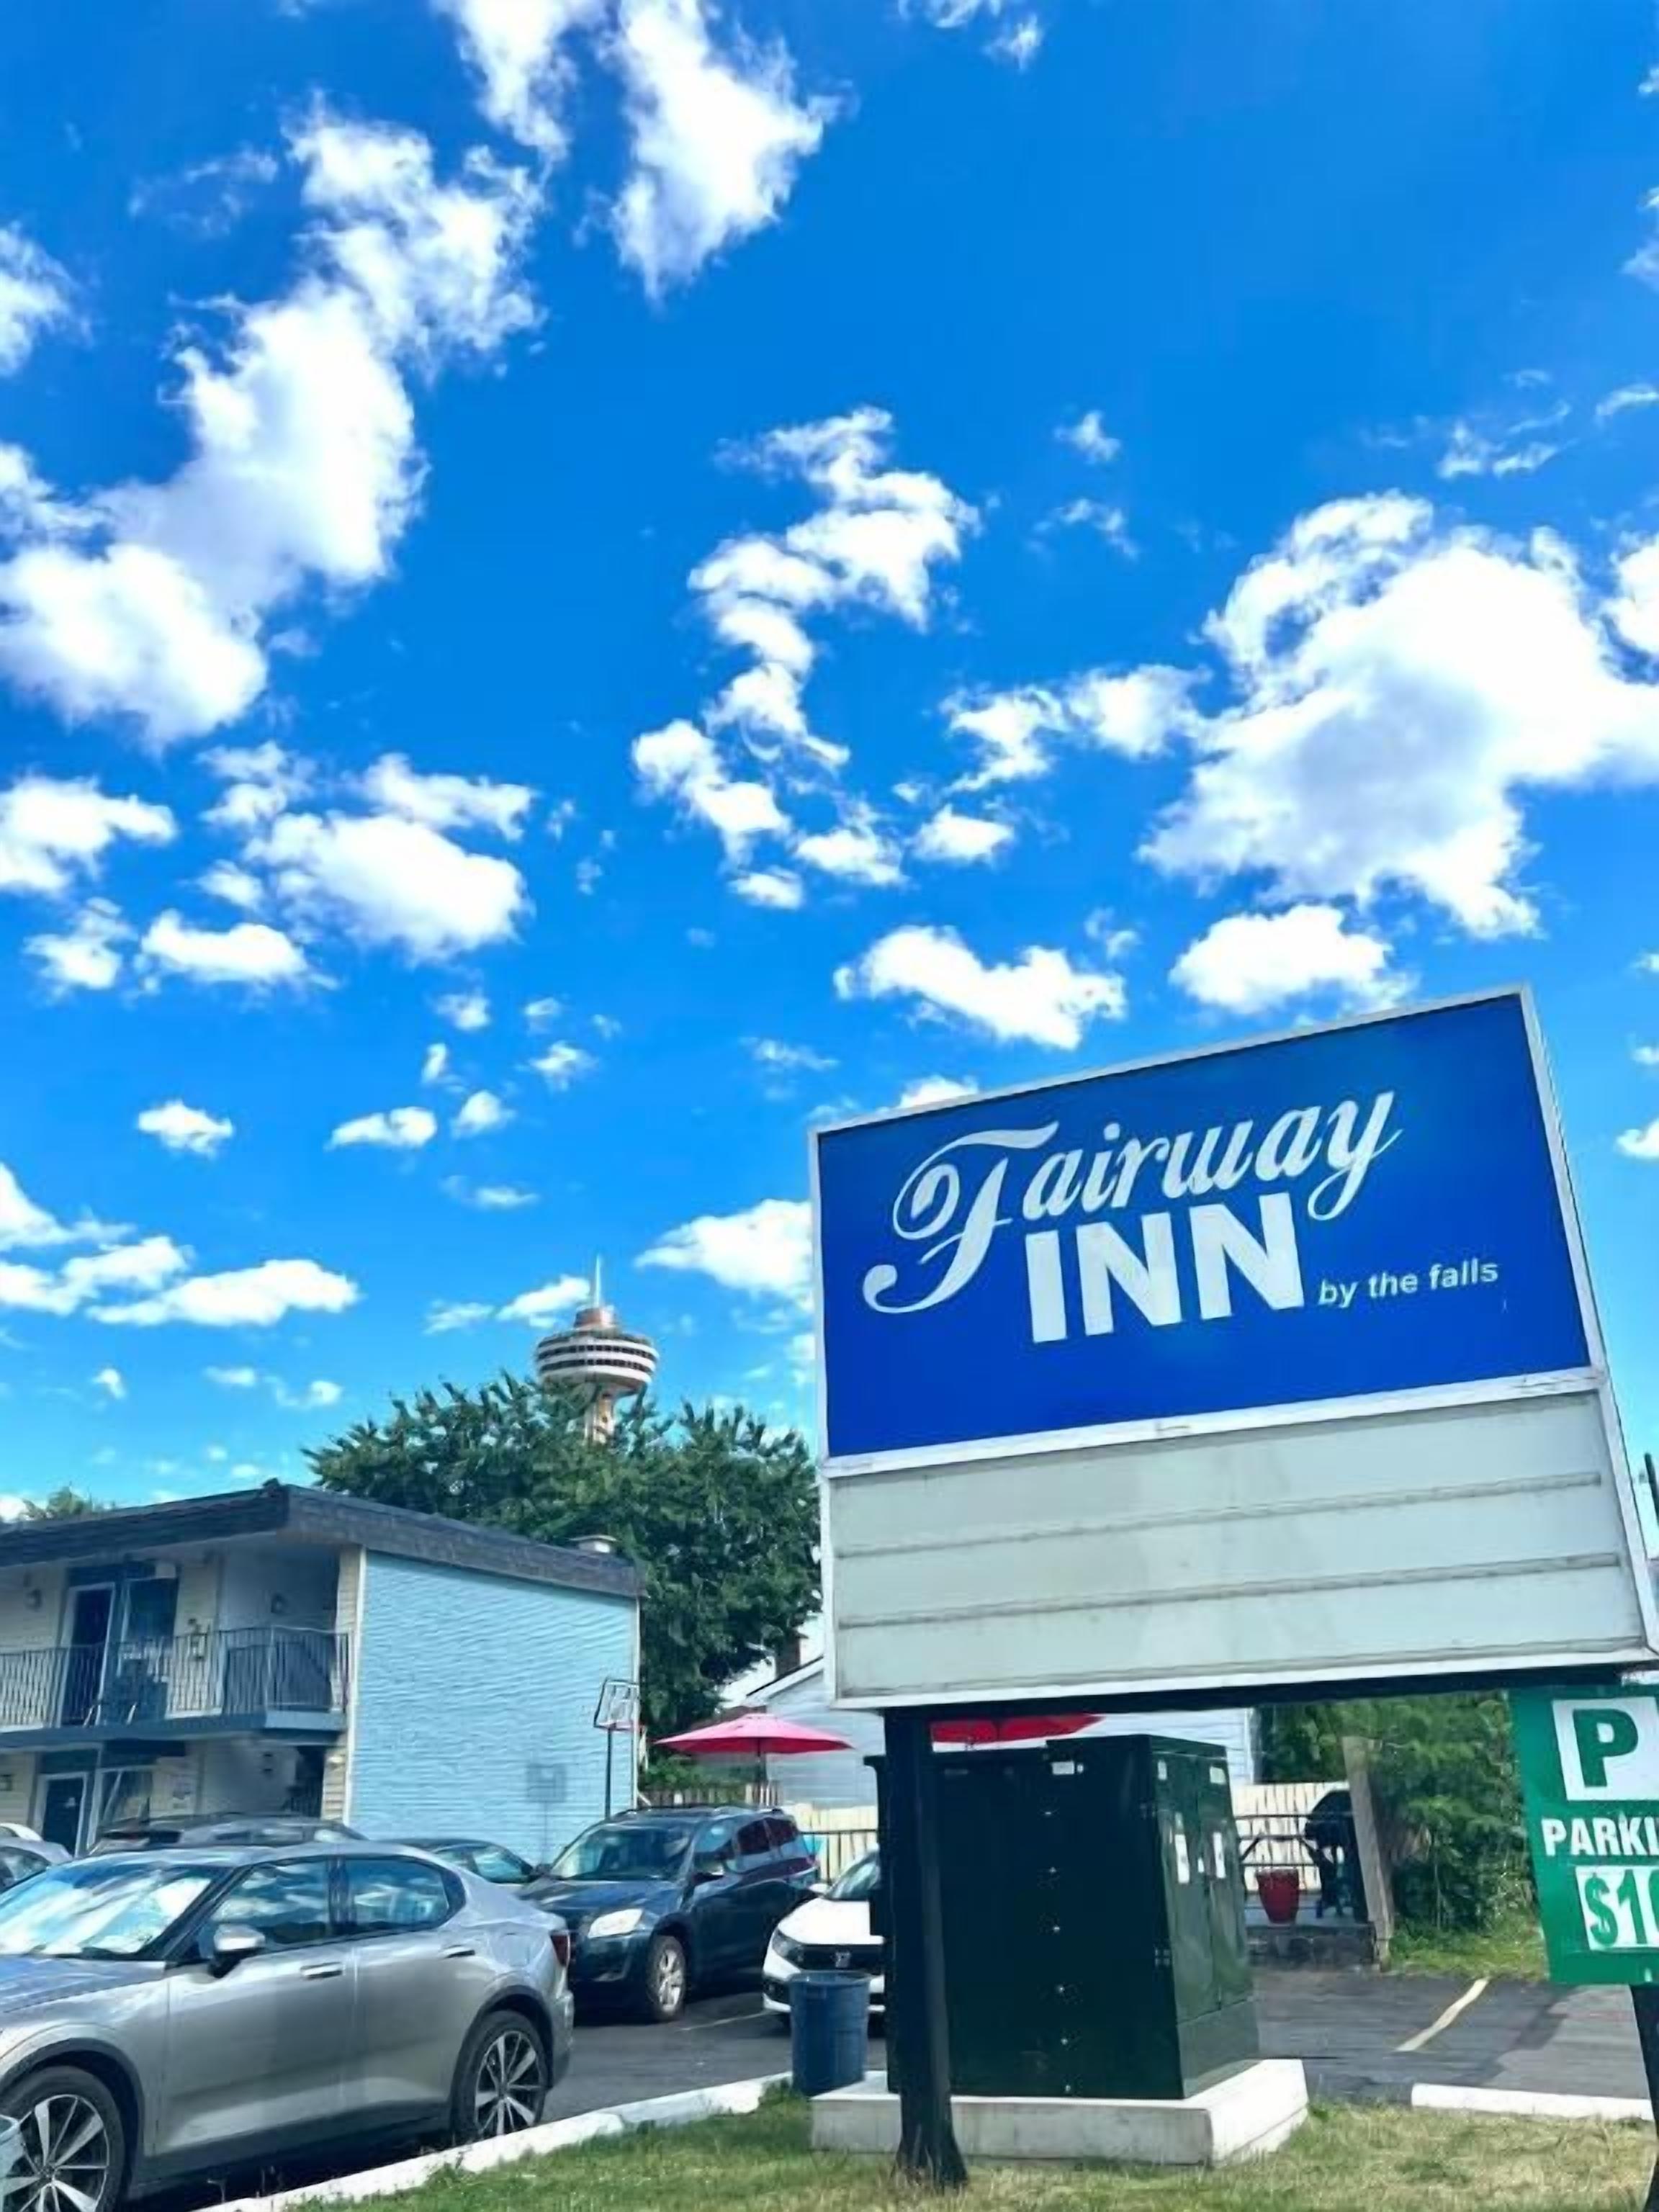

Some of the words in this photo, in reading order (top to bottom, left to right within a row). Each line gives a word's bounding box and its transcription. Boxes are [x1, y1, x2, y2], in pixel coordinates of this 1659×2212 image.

[863, 1092, 1401, 1313] Fairway
[1025, 1192, 1305, 1344] INN
[1318, 1280, 1358, 1308] by
[1368, 1272, 1418, 1298] the
[1429, 1257, 1498, 1290] falls
[1572, 1708, 1639, 1788] P
